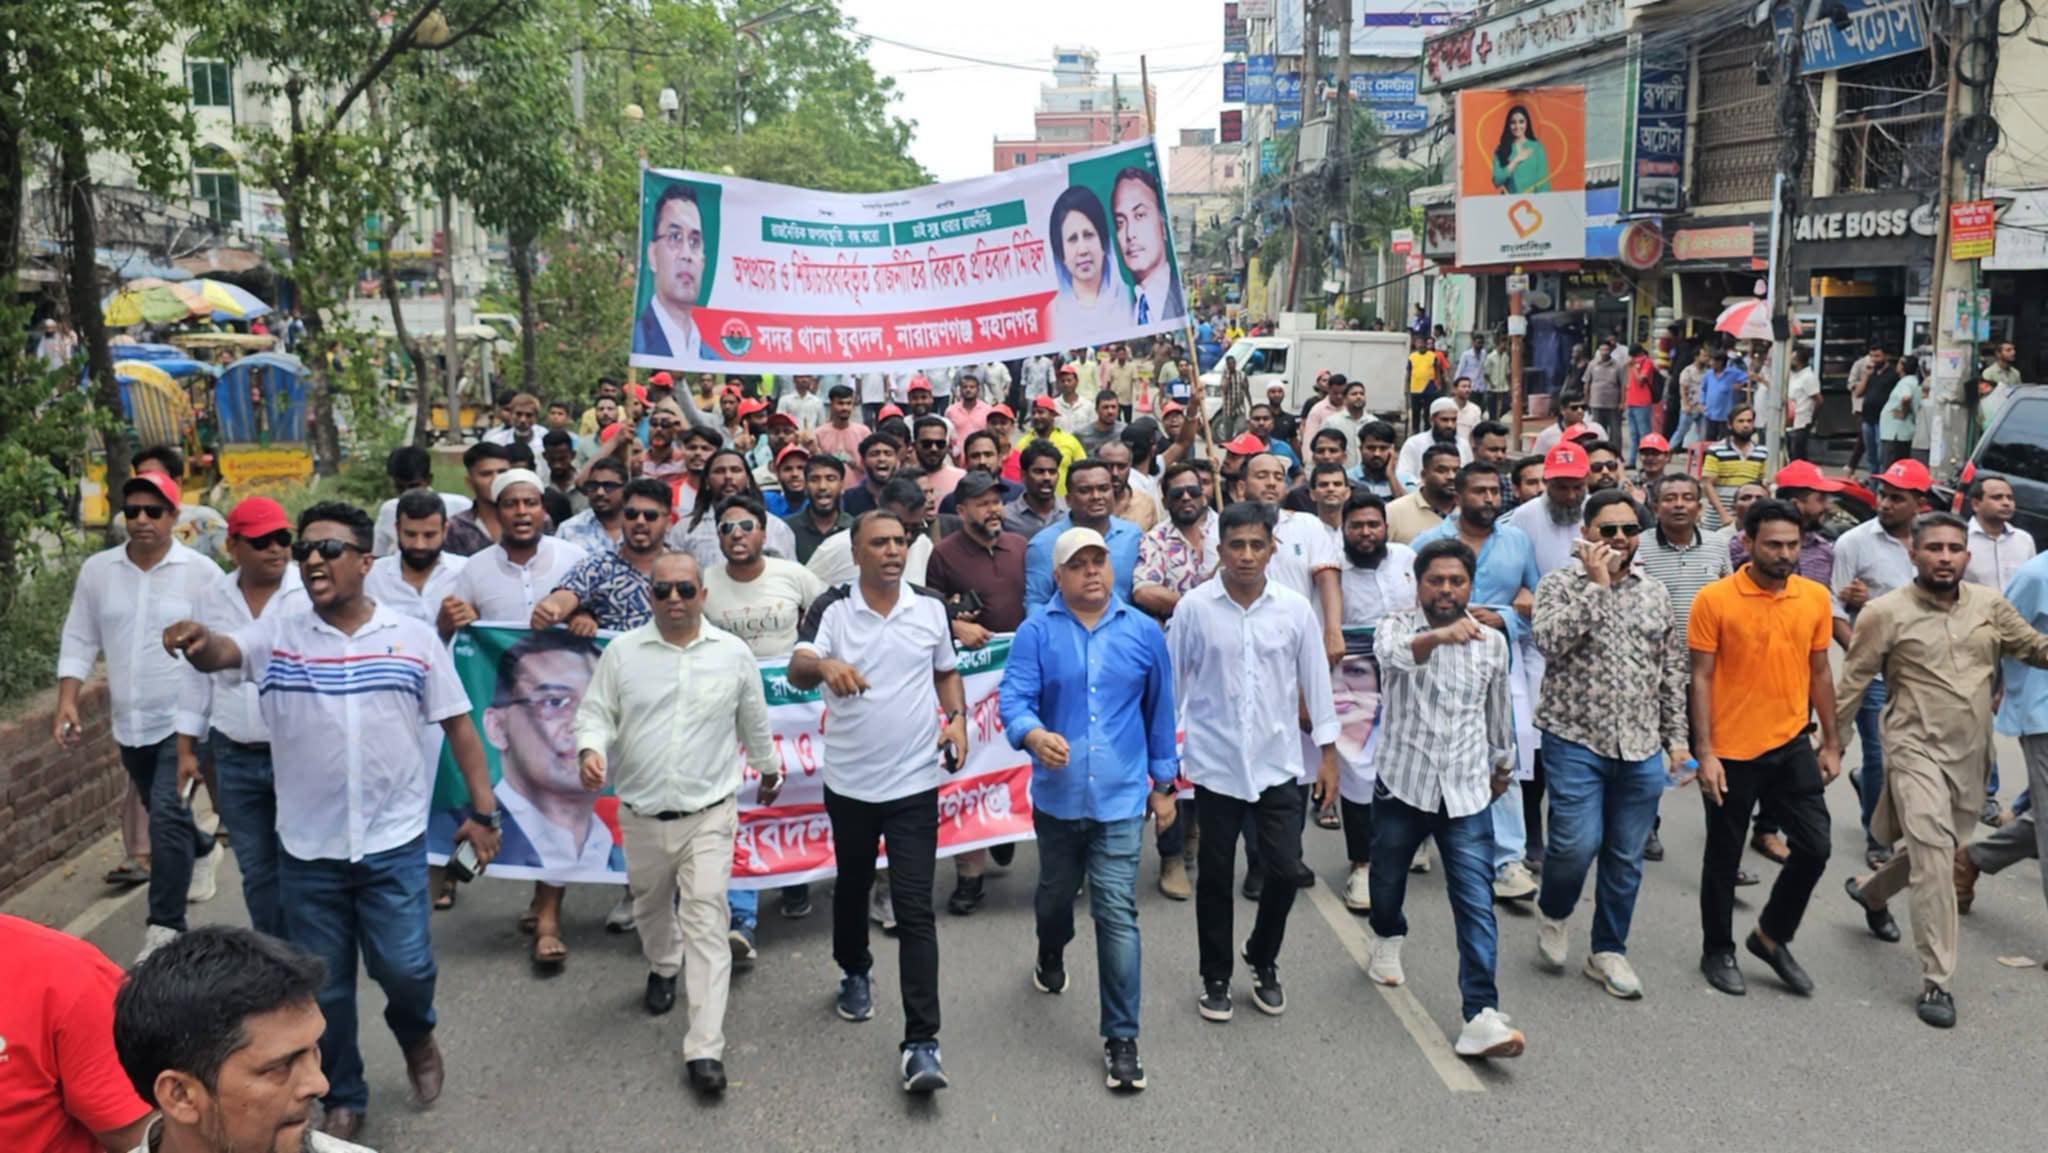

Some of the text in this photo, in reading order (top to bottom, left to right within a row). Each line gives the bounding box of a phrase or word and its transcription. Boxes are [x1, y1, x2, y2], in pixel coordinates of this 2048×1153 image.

[1793, 213, 1843, 240] AKE
[1846, 208, 1908, 238] BOSS
[732, 256, 776, 291] অপপ্রচার
[781, 263, 790, 291] ও
[872, 249, 928, 293] রাজনীতির
[928, 246, 968, 289] বিরুদ্ধে
[970, 237, 1011, 283] প্রতিবাদ
[1012, 228, 1049, 278] মিছিল
[756, 325, 793, 353] সদর
[797, 325, 833, 354] থানা
[894, 317, 975, 350] নারায়ণগঞ্জ
[975, 307, 1039, 341] মহানগর
